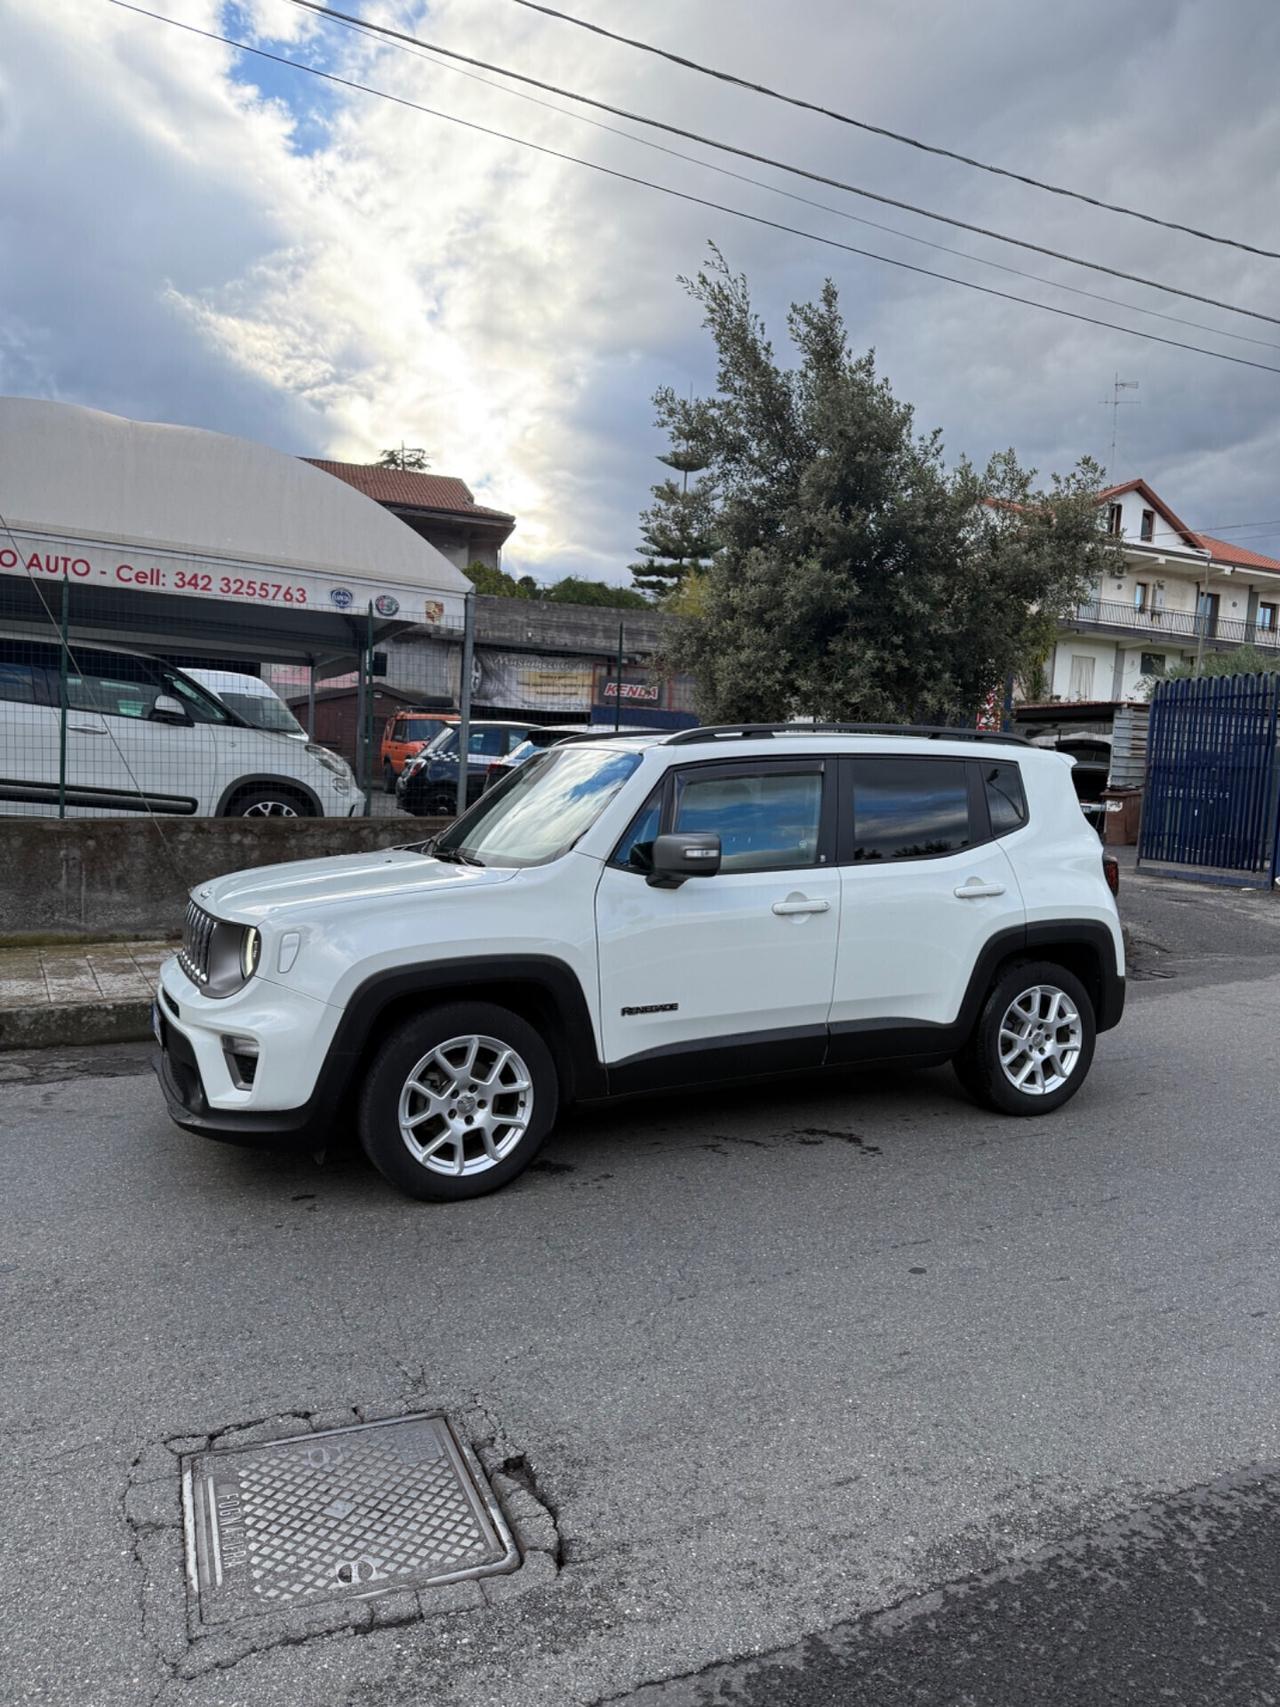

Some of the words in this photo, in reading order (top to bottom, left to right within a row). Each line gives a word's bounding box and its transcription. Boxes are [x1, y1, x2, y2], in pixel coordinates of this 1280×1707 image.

[26, 552, 91, 577] AUTO
[115, 564, 166, 586] Cell:
[174, 571, 213, 592] 342
[219, 576, 307, 604] 3255763
